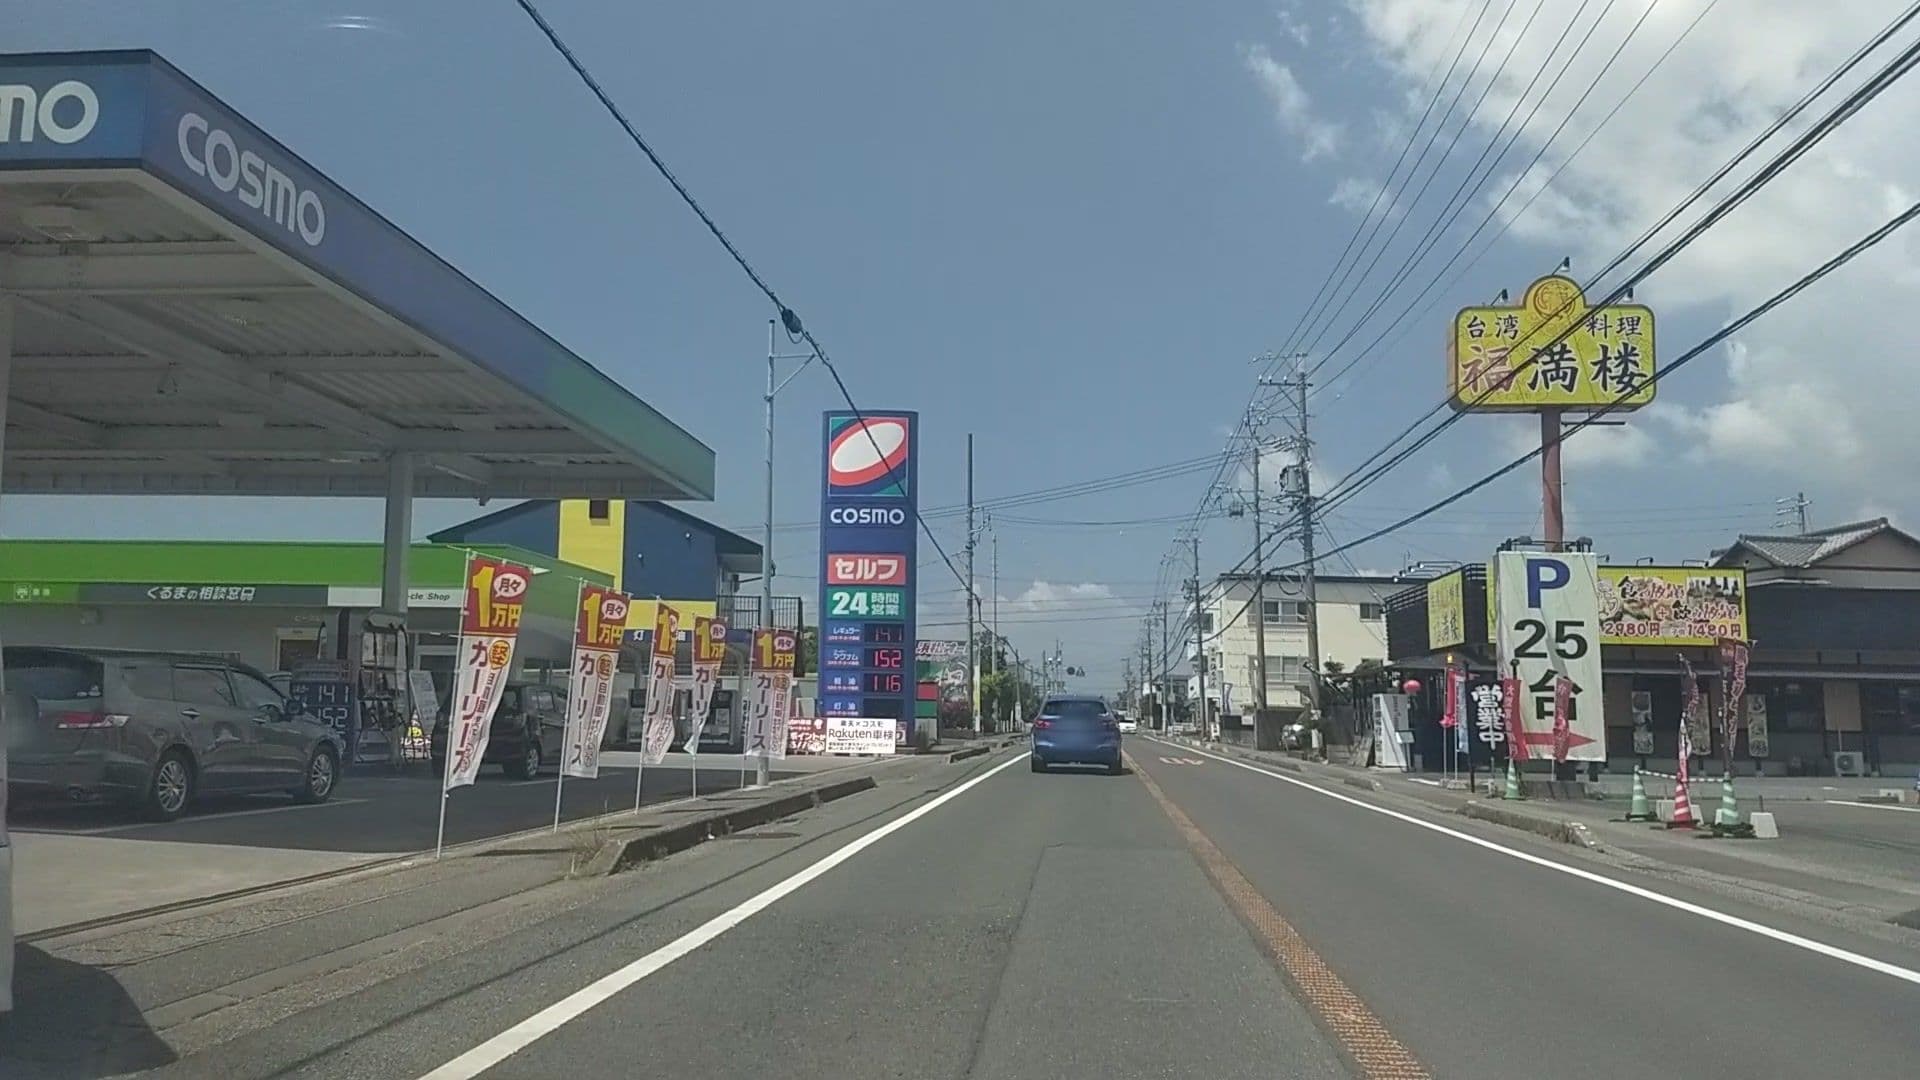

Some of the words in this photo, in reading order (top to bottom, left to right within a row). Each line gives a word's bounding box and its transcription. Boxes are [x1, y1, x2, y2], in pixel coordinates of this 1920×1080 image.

[178, 112, 325, 246] COSMO
[1467, 315, 1519, 340] 台湾
[1586, 314, 1642, 339] 料理
[1461, 342, 1648, 395] 福満楼
[831, 508, 905, 524] COSMO
[835, 560, 898, 580] セルフ
[499, 577, 519, 593] 月々
[1527, 558, 1570, 608] P
[147, 587, 256, 601] くるまの相談窓口
[427, 593, 450, 601] Shop
[832, 591, 869, 615] 24
[871, 592, 899, 603] 時間
[605, 602, 625, 616] 月々
[871, 604, 899, 616] 営業
[875, 627, 902, 642] 141
[1604, 621, 1661, 636] 2980円
[1514, 619, 1588, 659] 25
[875, 649, 902, 668] 152
[874, 674, 902, 692] 116
[318, 685, 350, 704] 141
[1529, 668, 1583, 721] 台
[453, 641, 489, 776] カーリース
[571, 653, 595, 765] カーリース
[751, 675, 773, 749] カーリース
[1471, 684, 1506, 750] 営業中
